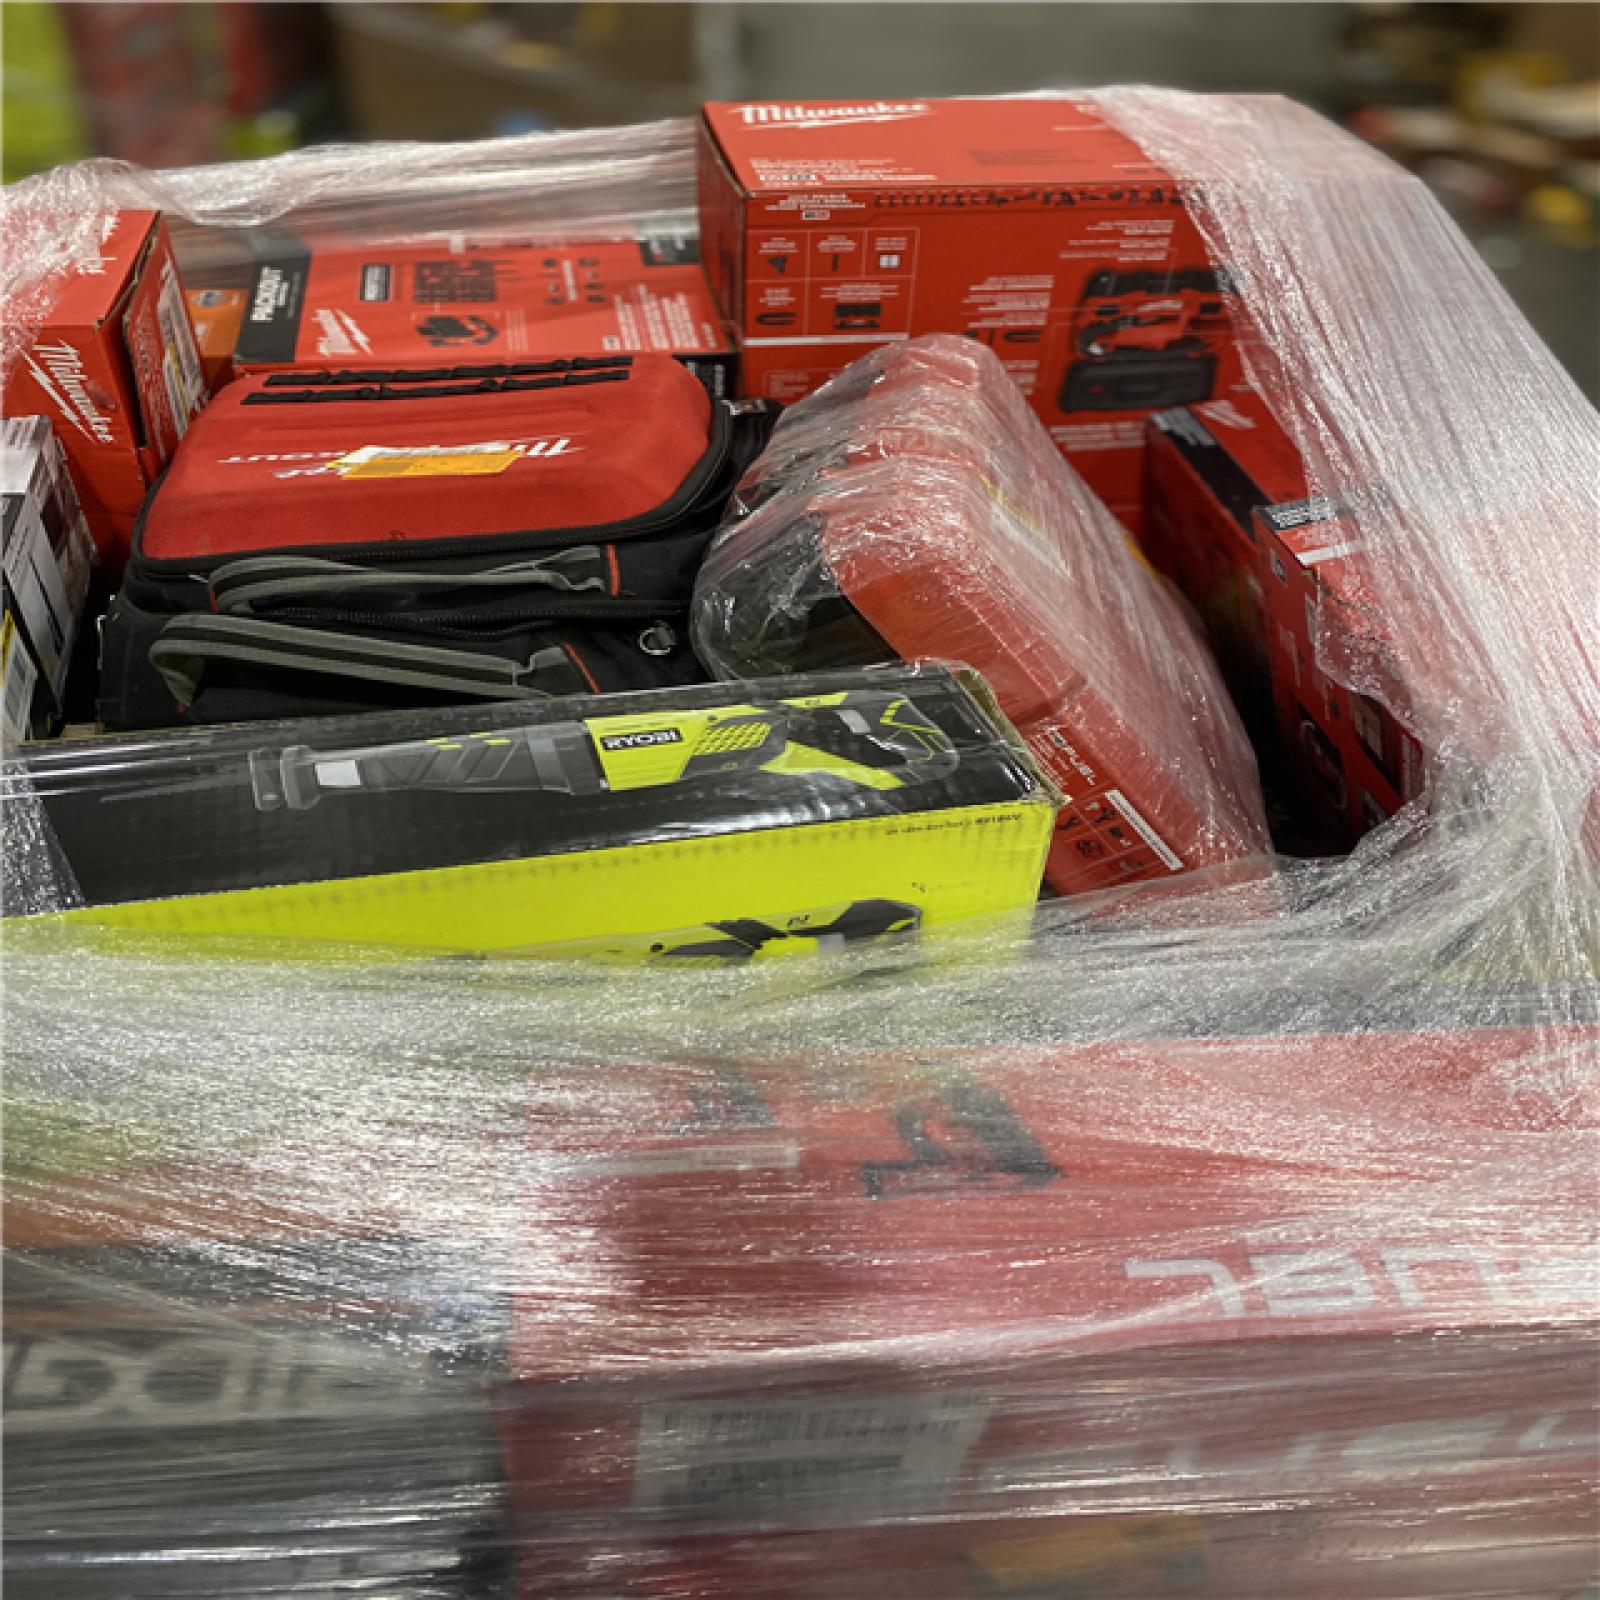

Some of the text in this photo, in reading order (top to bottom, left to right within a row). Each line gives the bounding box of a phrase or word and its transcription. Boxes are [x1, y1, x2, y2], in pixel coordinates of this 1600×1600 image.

[730, 102, 932, 127] Milwaukee
[31, 337, 116, 443] Milwaukee
[605, 730, 677, 750] RYOBI
